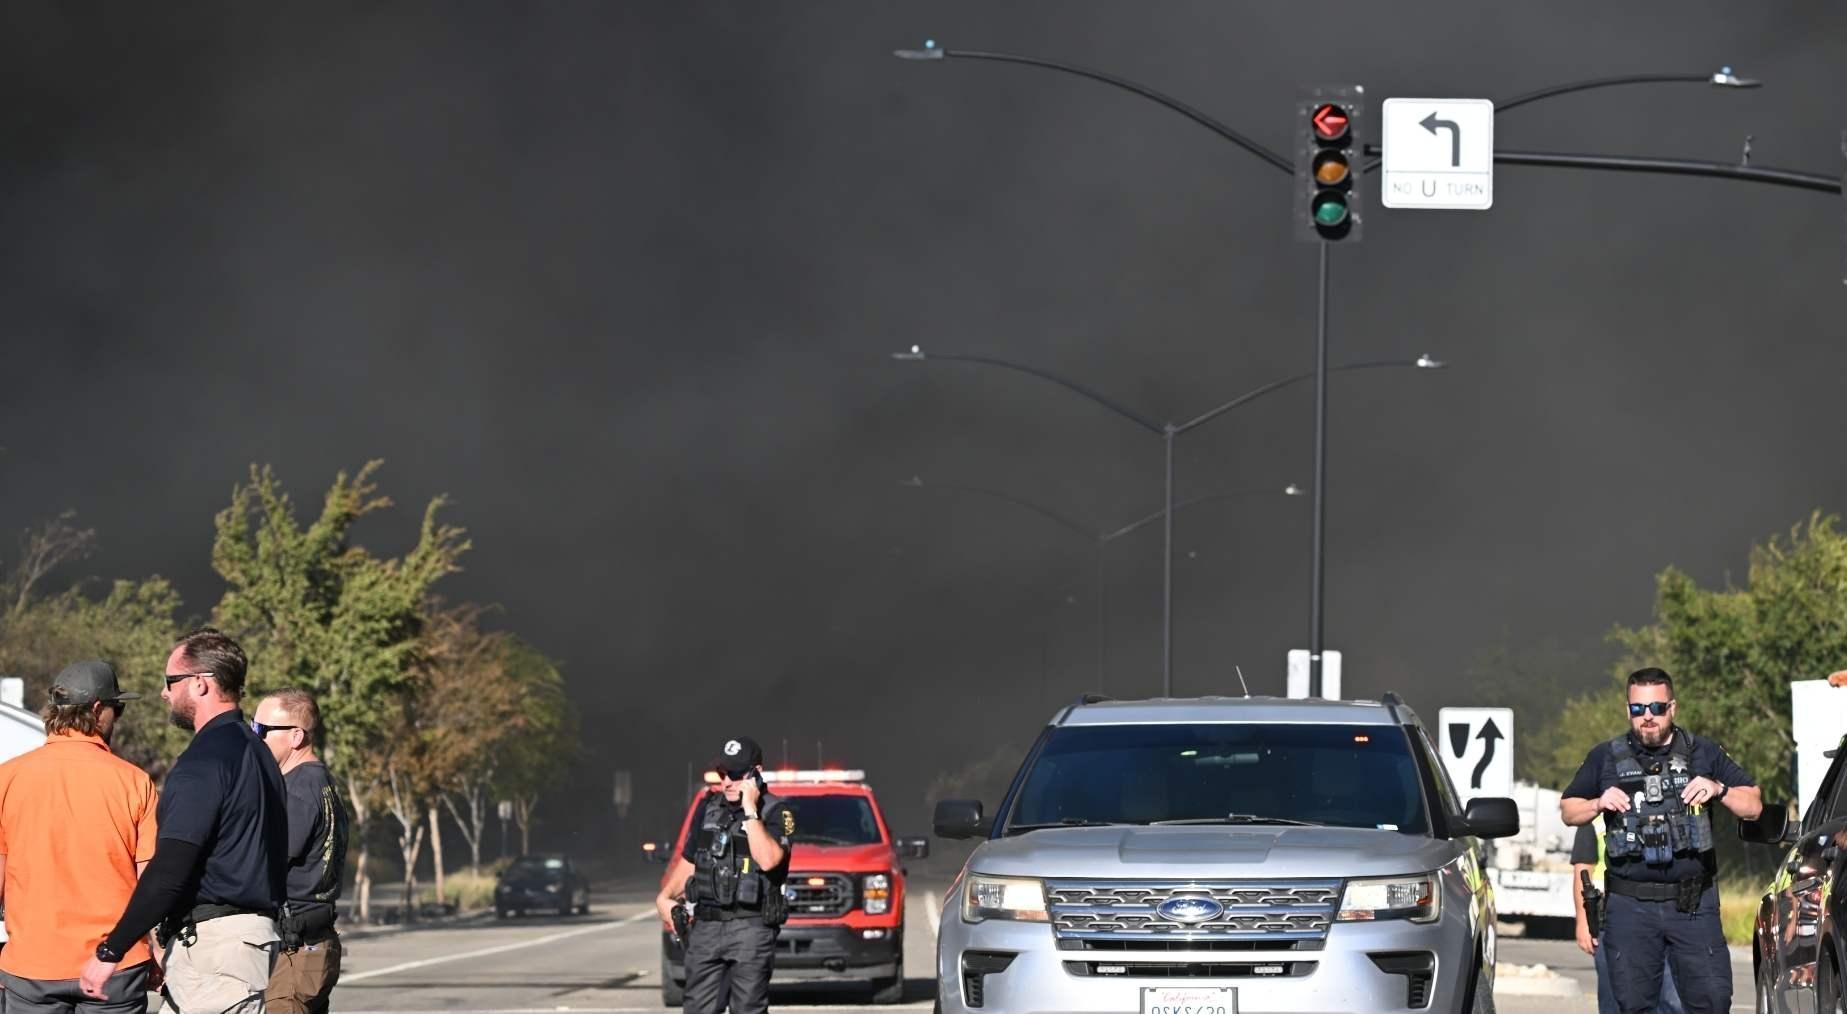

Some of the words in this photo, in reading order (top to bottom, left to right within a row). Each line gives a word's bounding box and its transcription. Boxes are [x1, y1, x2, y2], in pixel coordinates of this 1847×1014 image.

[1393, 182, 1412, 195] NO
[1422, 179, 1437, 198] U
[1448, 182, 1484, 195] TURN
